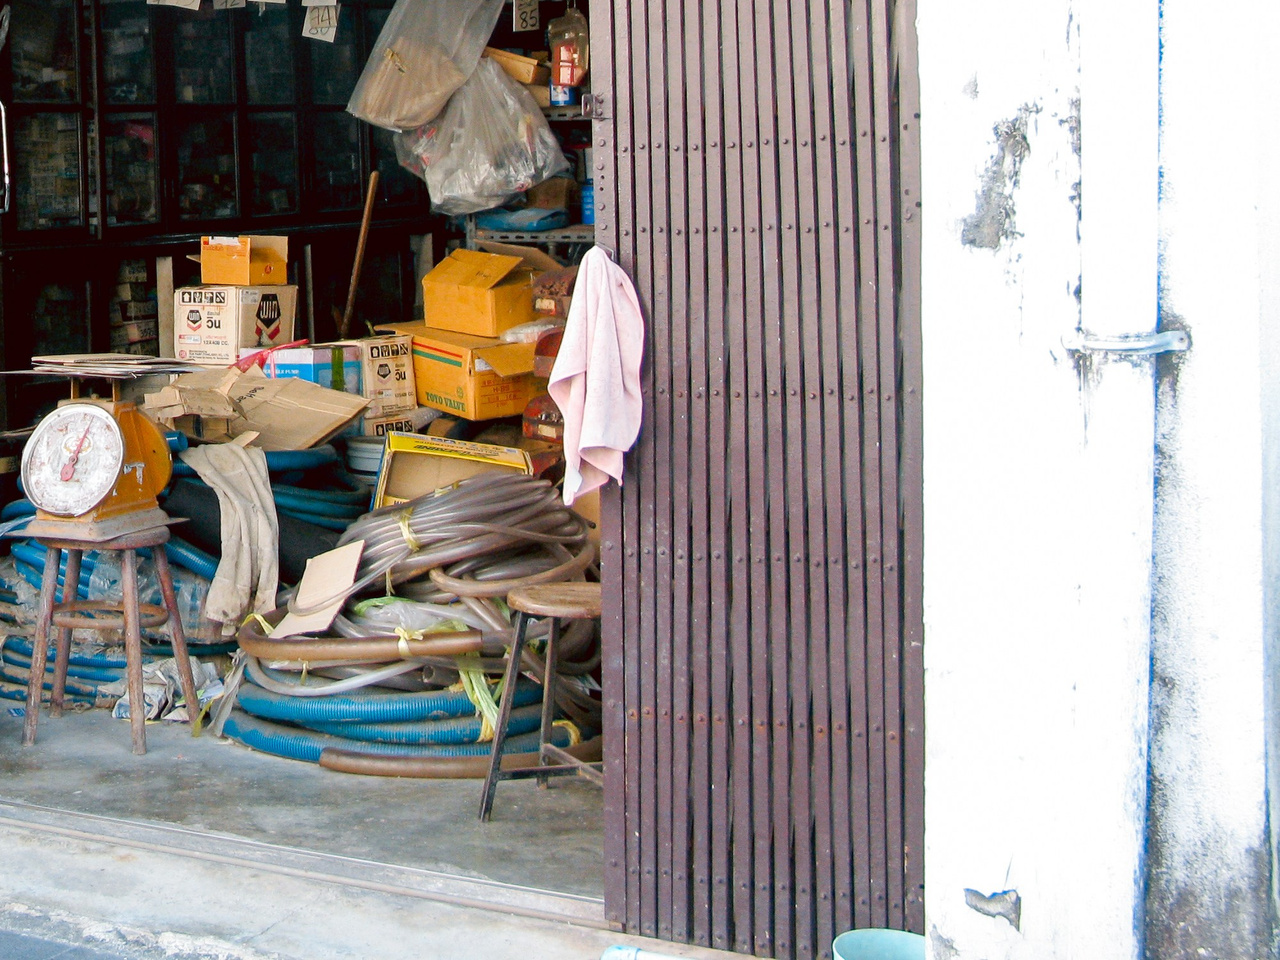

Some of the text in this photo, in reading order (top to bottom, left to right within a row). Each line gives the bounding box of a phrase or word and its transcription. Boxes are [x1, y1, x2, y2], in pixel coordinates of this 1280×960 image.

[520, 9, 538, 29] 85
[425, 391, 443, 405] TOYO
[444, 397, 466, 412] VALVE
